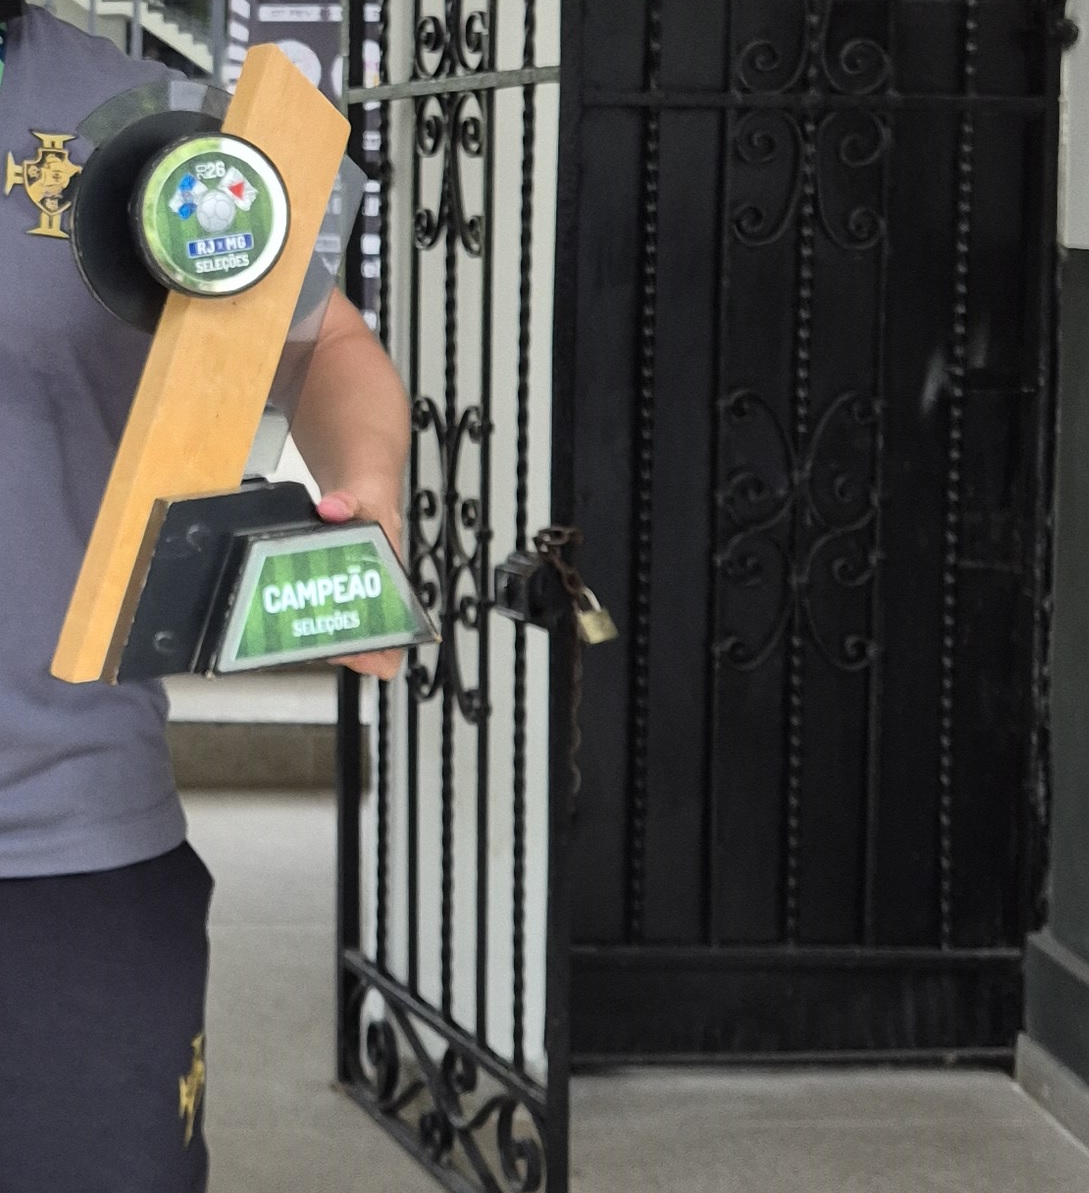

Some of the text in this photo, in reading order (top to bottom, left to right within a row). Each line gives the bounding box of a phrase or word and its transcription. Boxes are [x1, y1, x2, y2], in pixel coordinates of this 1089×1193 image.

[196, 240, 215, 255] RJ
[226, 237, 247, 251] MG
[195, 253, 250, 274] SELEÇÕES
[264, 565, 381, 613] CAMPEÃO
[291, 611, 360, 638] SELEÇÕES
